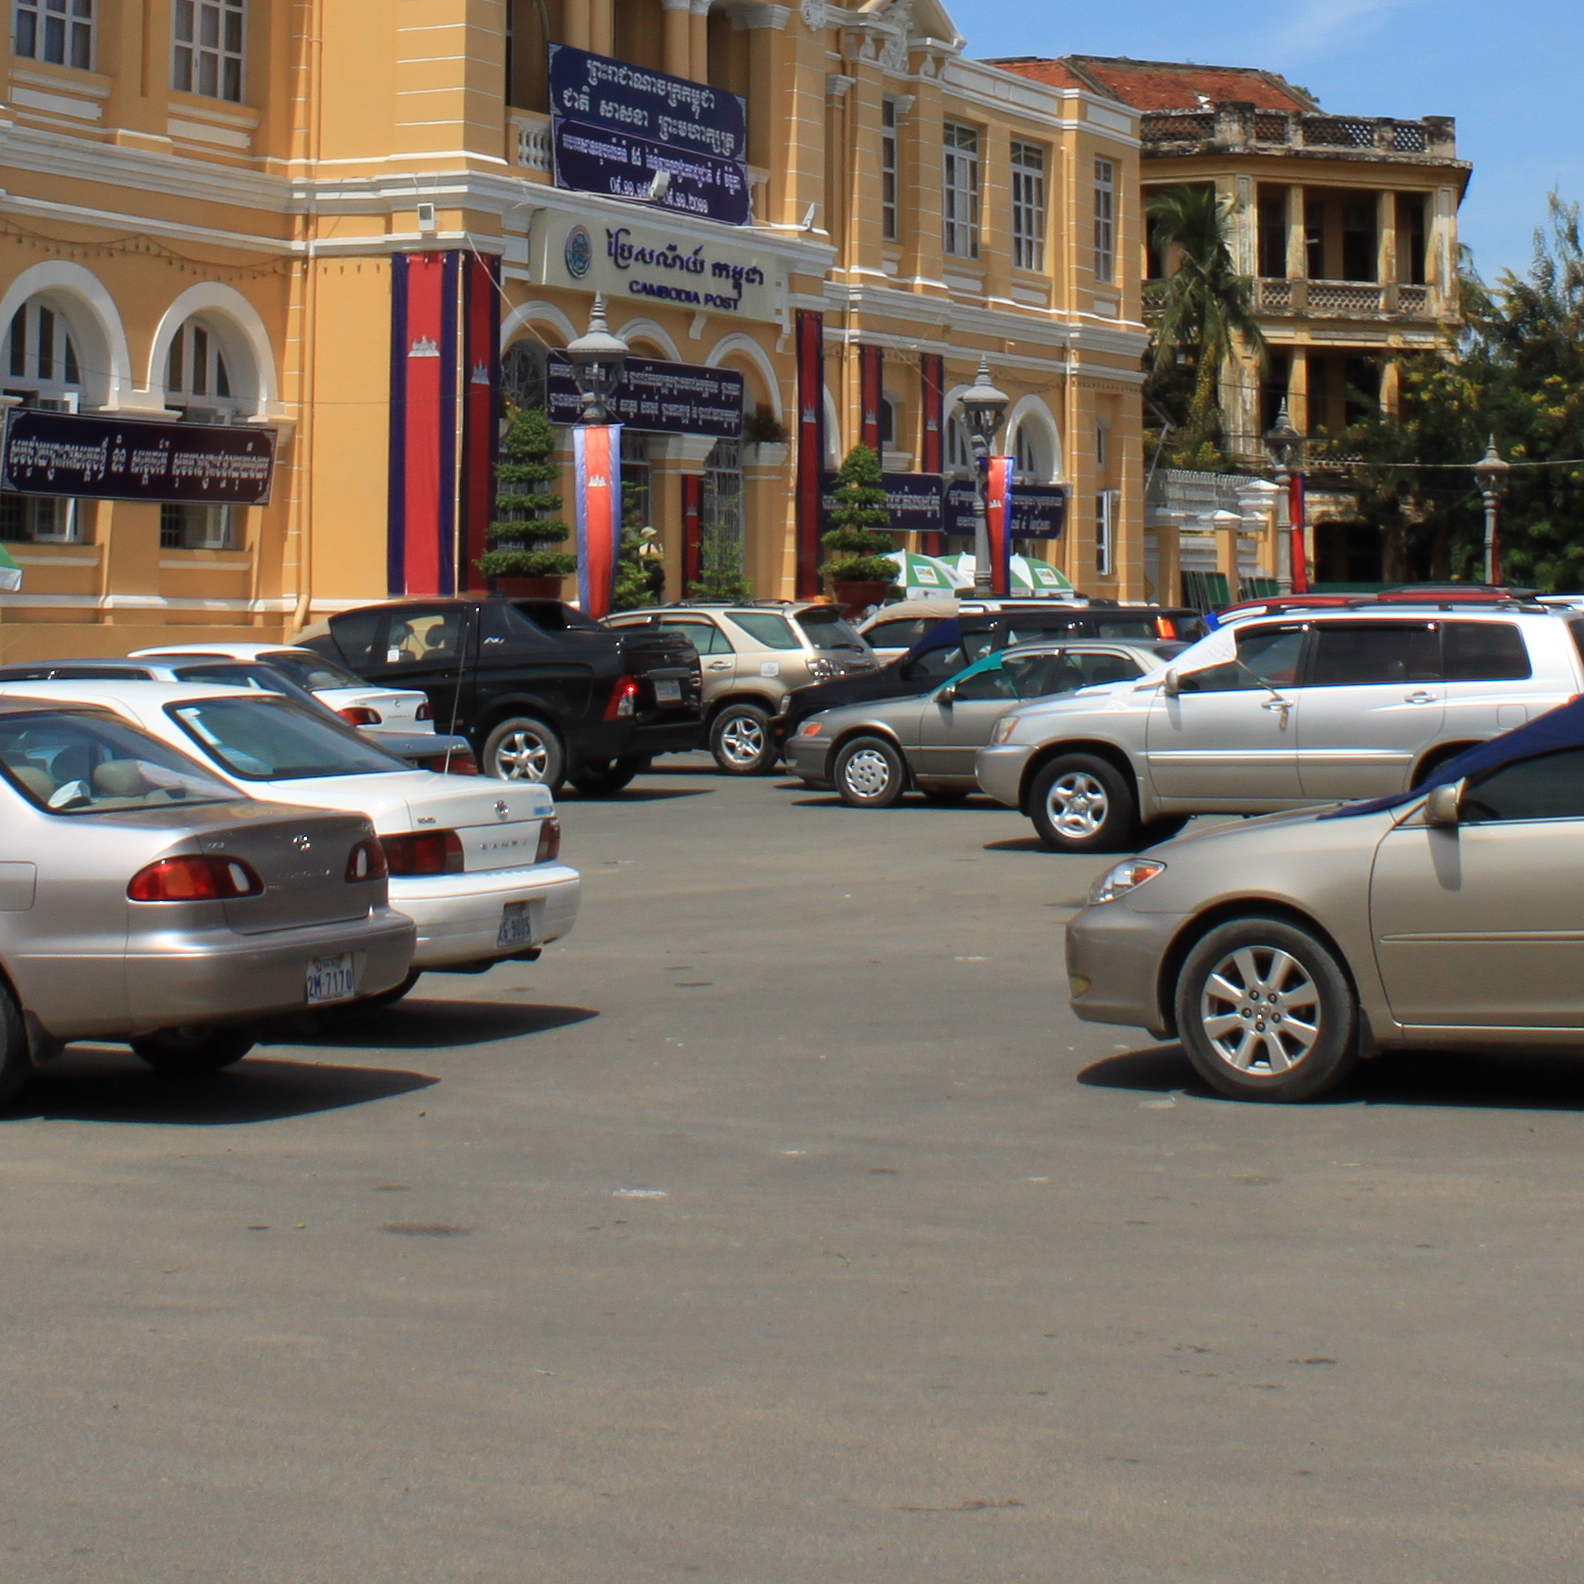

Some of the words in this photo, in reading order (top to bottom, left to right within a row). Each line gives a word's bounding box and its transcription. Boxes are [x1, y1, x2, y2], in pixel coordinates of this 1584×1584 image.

[563, 86, 590, 111] ជាតិ
[600, 100, 648, 127] សាសនា
[628, 280, 700, 305] CAMBODIA
[704, 293, 739, 311] POST
[711, 261, 764, 299] កម្ពុជា
